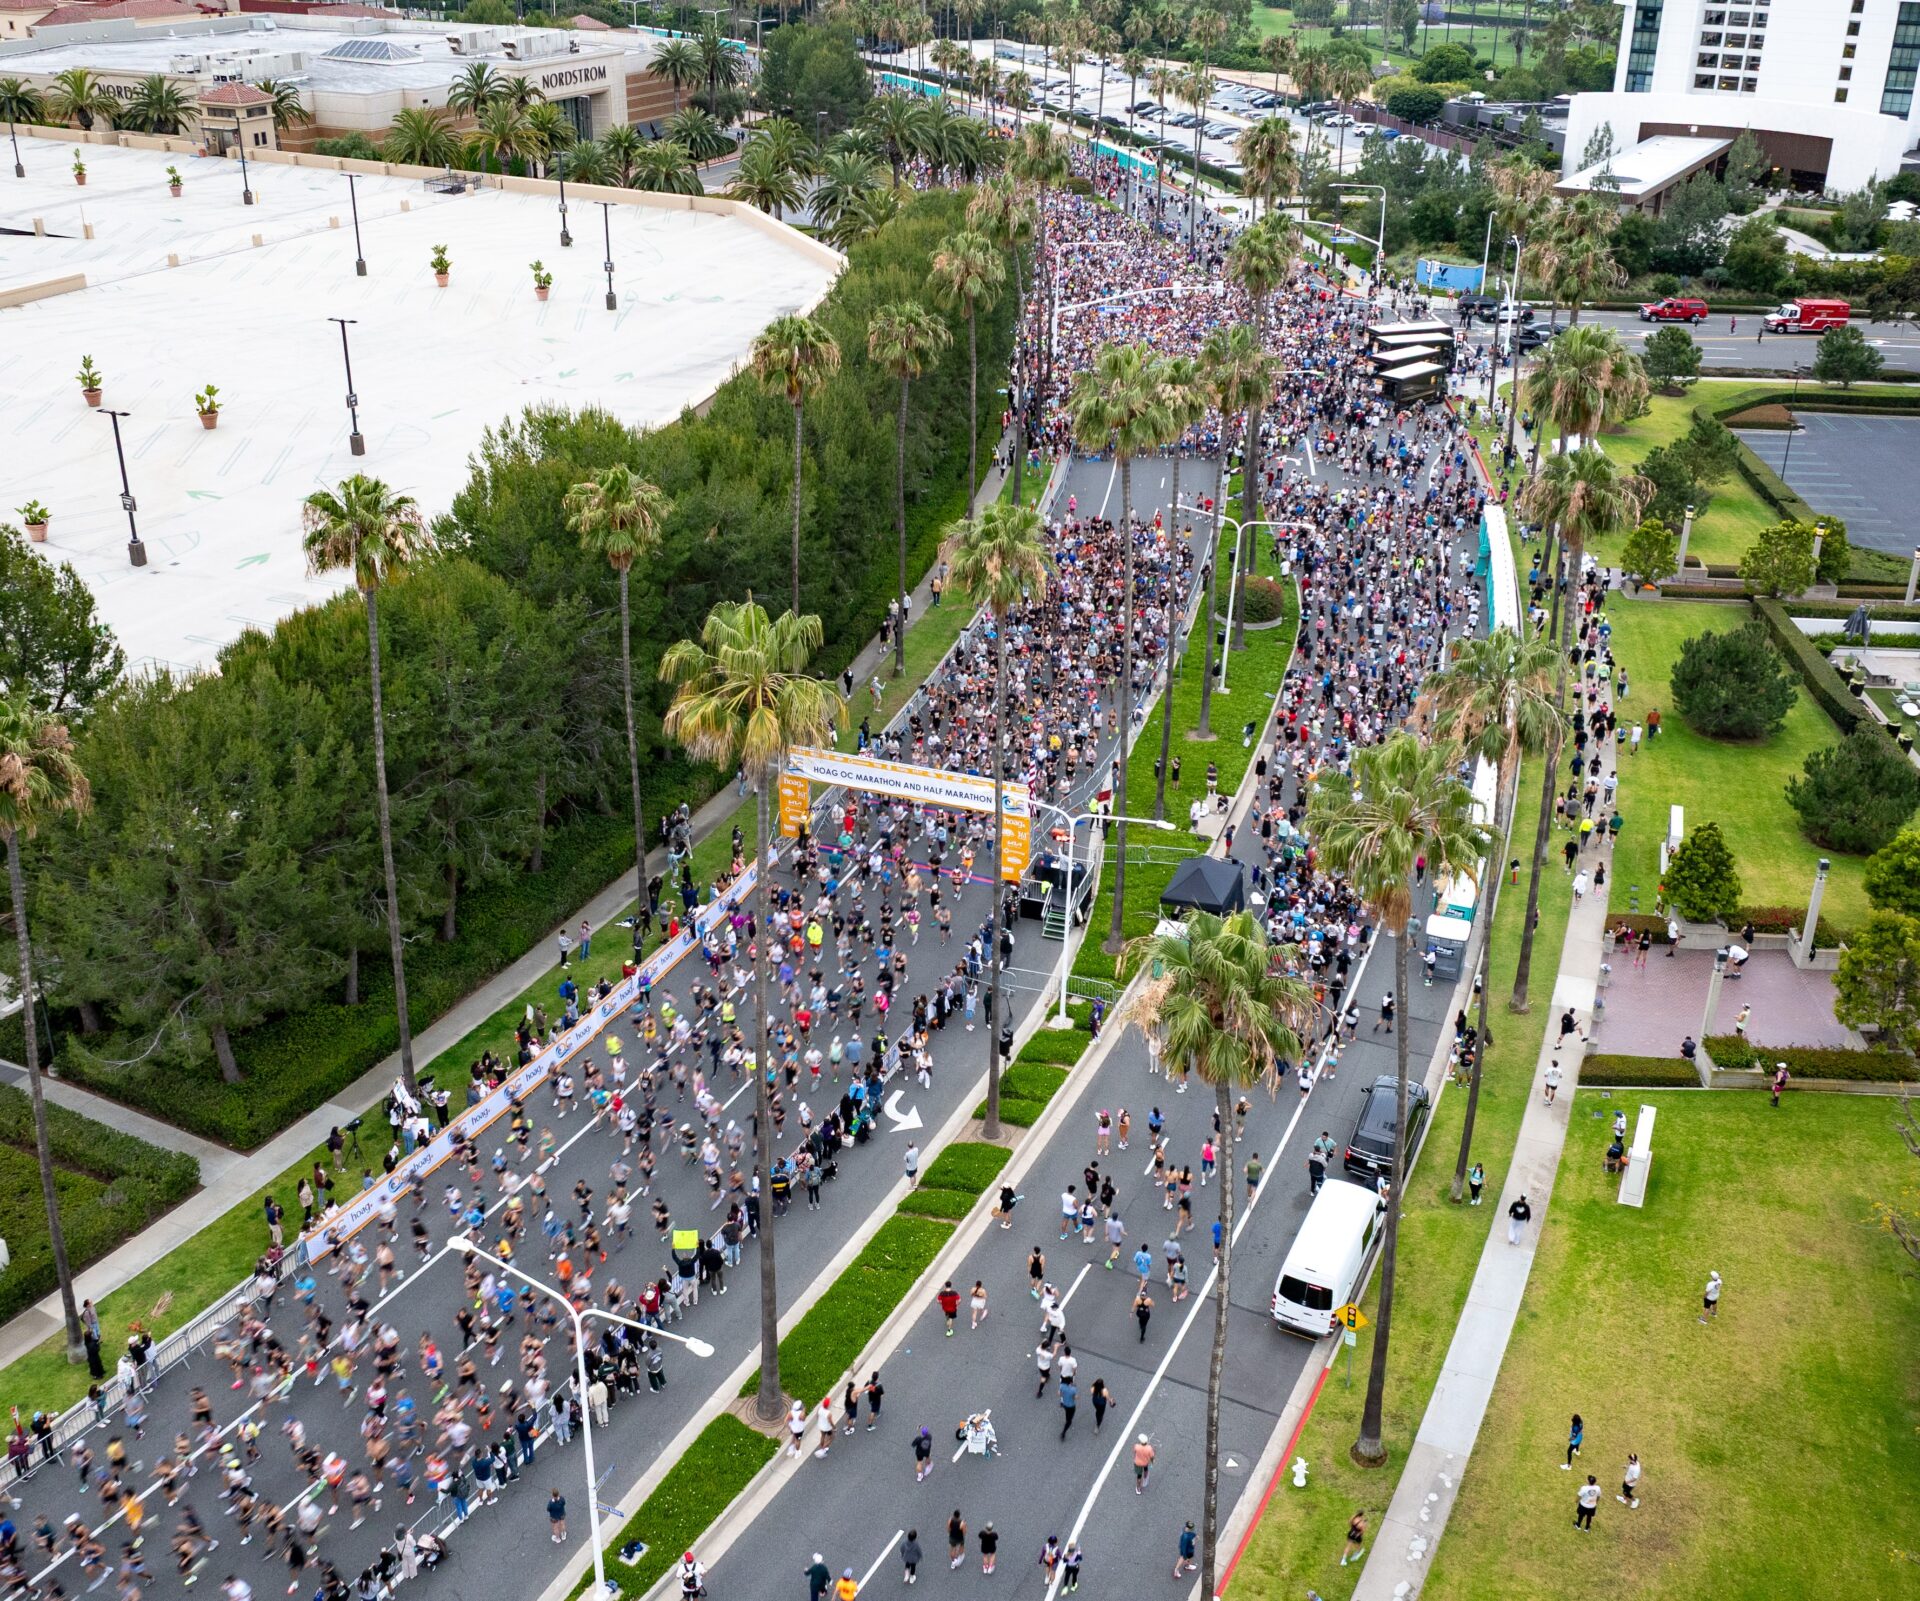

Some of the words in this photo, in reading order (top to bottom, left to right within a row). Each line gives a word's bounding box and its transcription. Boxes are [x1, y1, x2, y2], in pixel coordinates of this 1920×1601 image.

[542, 65, 607, 89] NORDSTROM
[813, 766, 838, 777] HOAG
[840, 771, 854, 780] OC
[855, 774, 901, 788] MARATHON
[903, 782, 921, 791] AND
[923, 785, 943, 795] HALF
[945, 789, 993, 804] MARATHON
